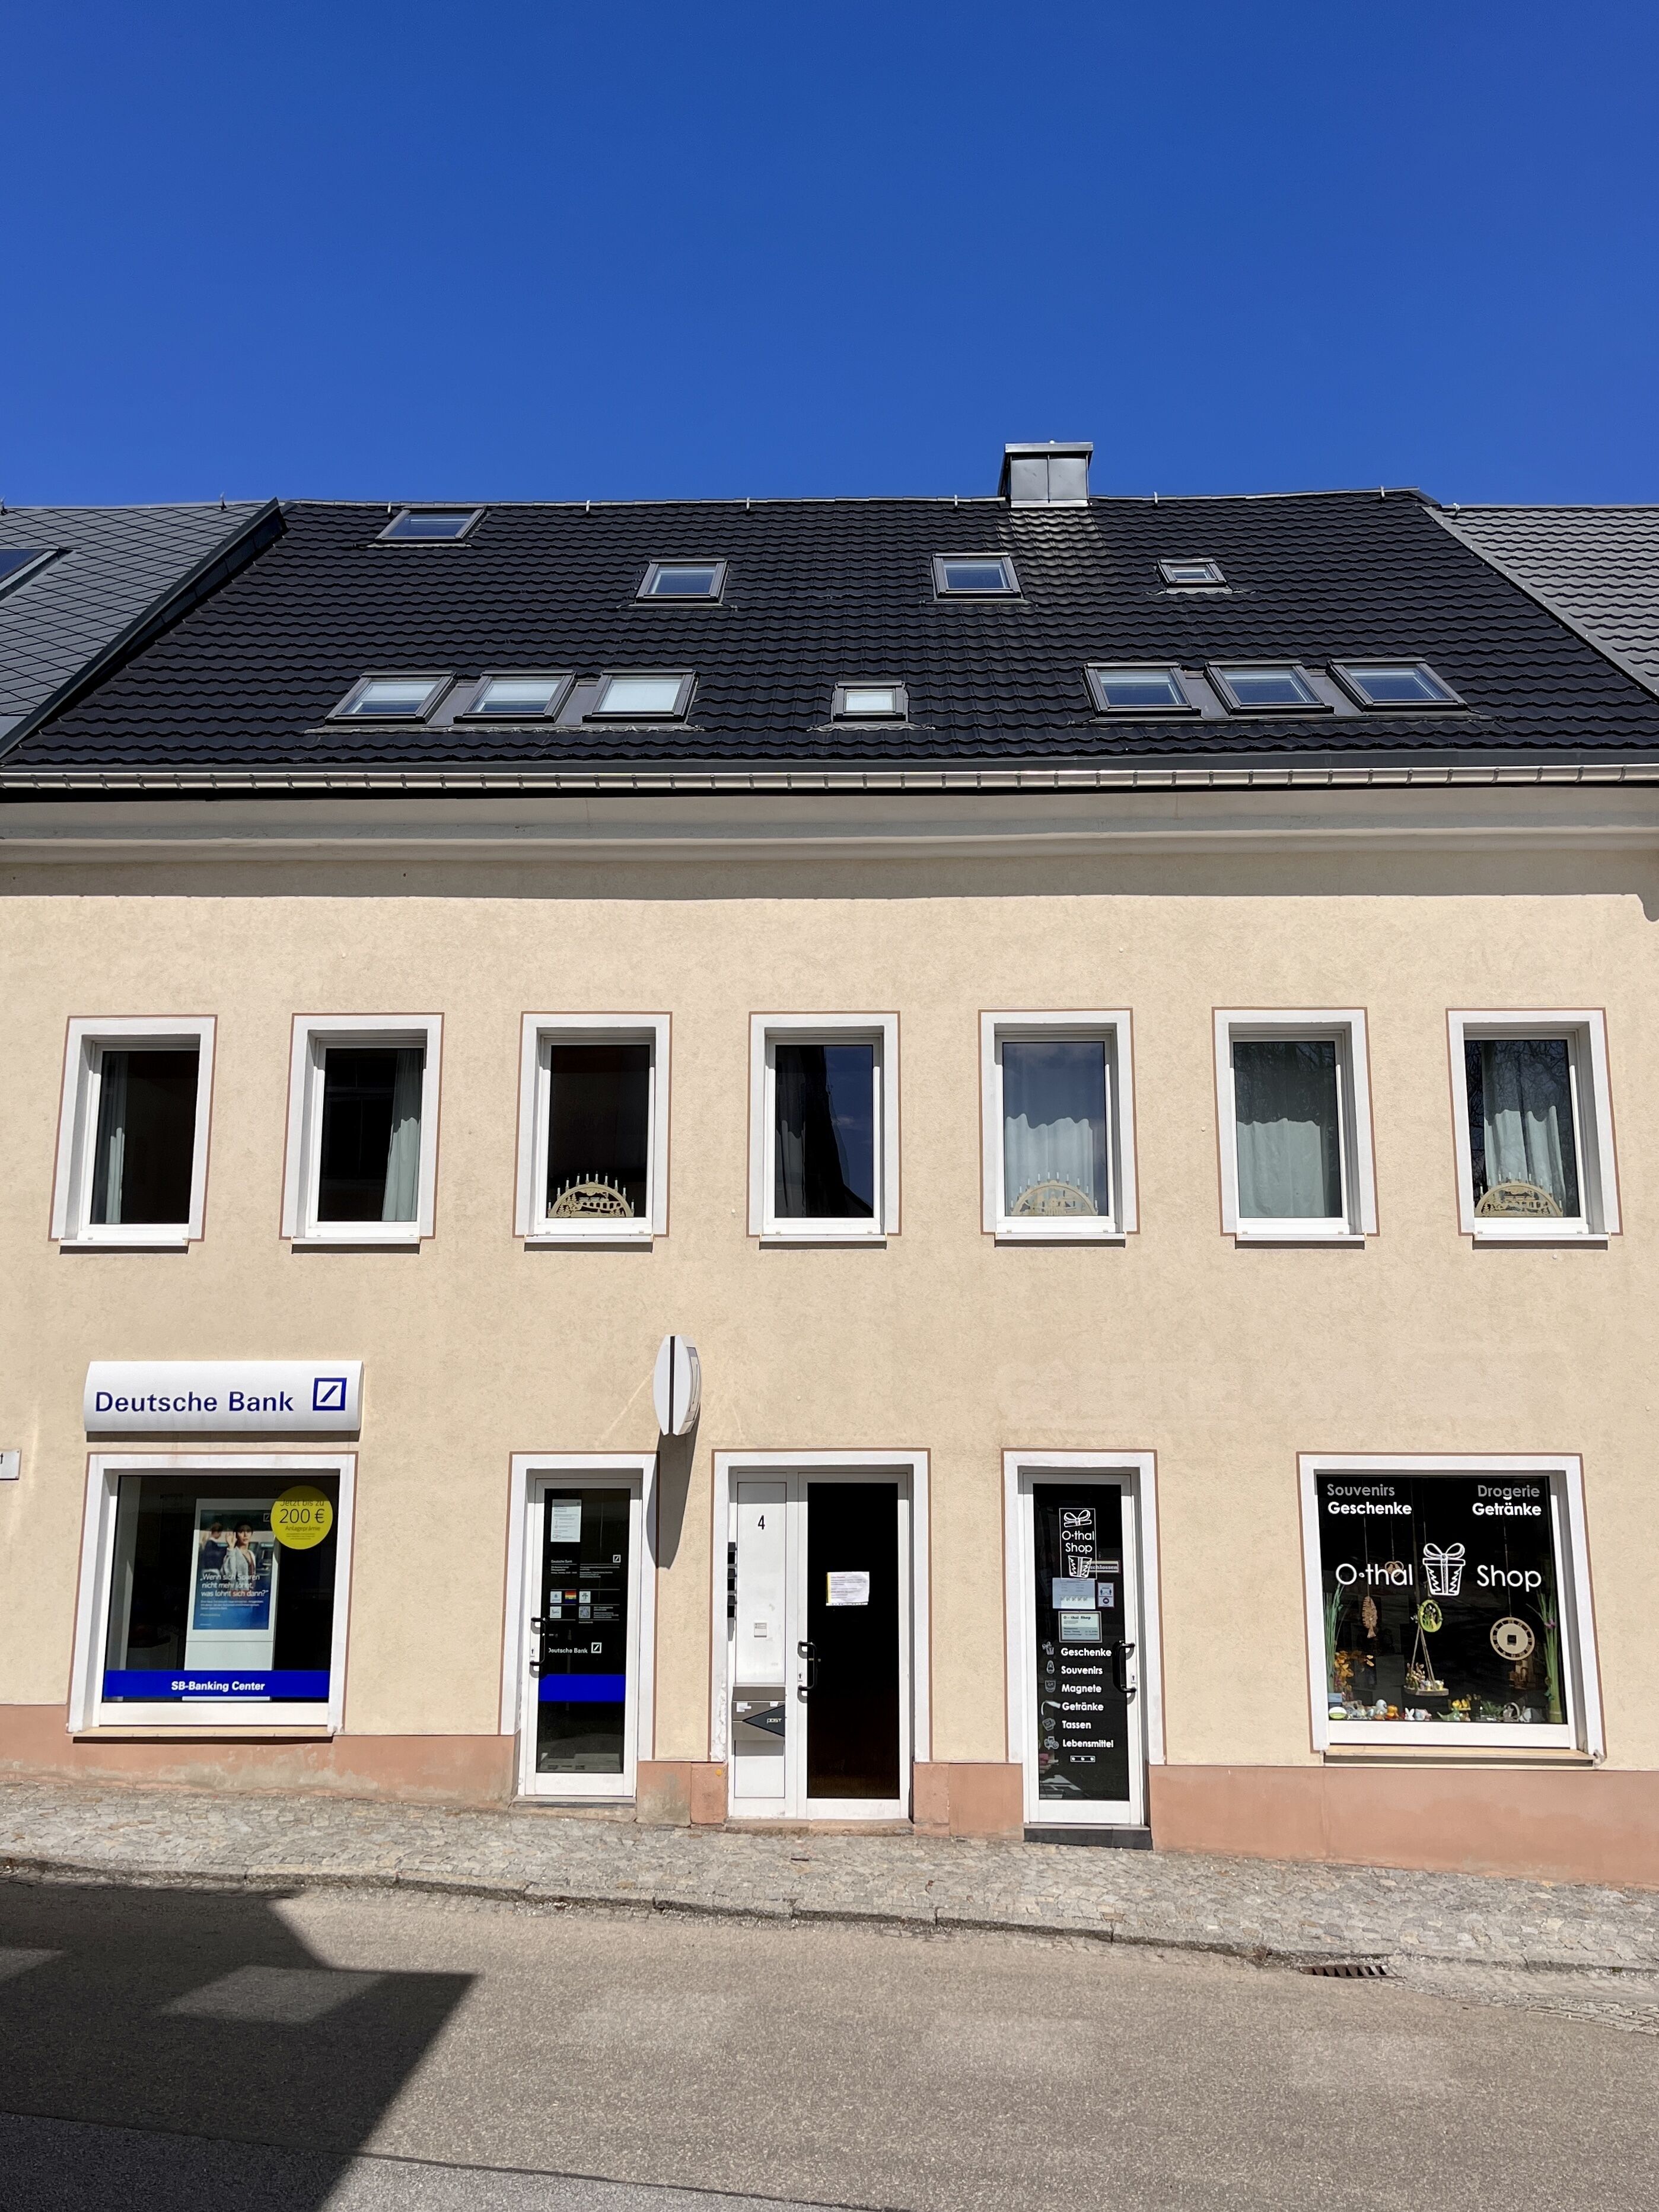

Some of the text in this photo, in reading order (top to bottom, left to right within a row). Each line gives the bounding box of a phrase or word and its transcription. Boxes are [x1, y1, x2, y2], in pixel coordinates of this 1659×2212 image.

[95, 1391, 294, 1412] Deutsche Bank
[1327, 1484, 1395, 1496] Souvenirs
[1478, 1485, 1540, 1500] Drogerie
[1327, 1501, 1412, 1514] Geschenke
[1472, 1503, 1542, 1516] Getränke
[279, 1508, 325, 1524] 200 €
[757, 1515, 765, 1530] 4
[1065, 1542, 1093, 1555] Shop
[1476, 1564, 1542, 1592] Shop
[1061, 1647, 1112, 1657] Geschenke
[1061, 1666, 1103, 1675] Souvenirs
[171, 1681, 265, 1692] SB-Banking Center
[1061, 1684, 1102, 1694] Magnete
[1062, 1702, 1104, 1711] Getränke
[1062, 1720, 1092, 1729] Tassen
[1062, 1739, 1114, 1748] Lebensmittel
